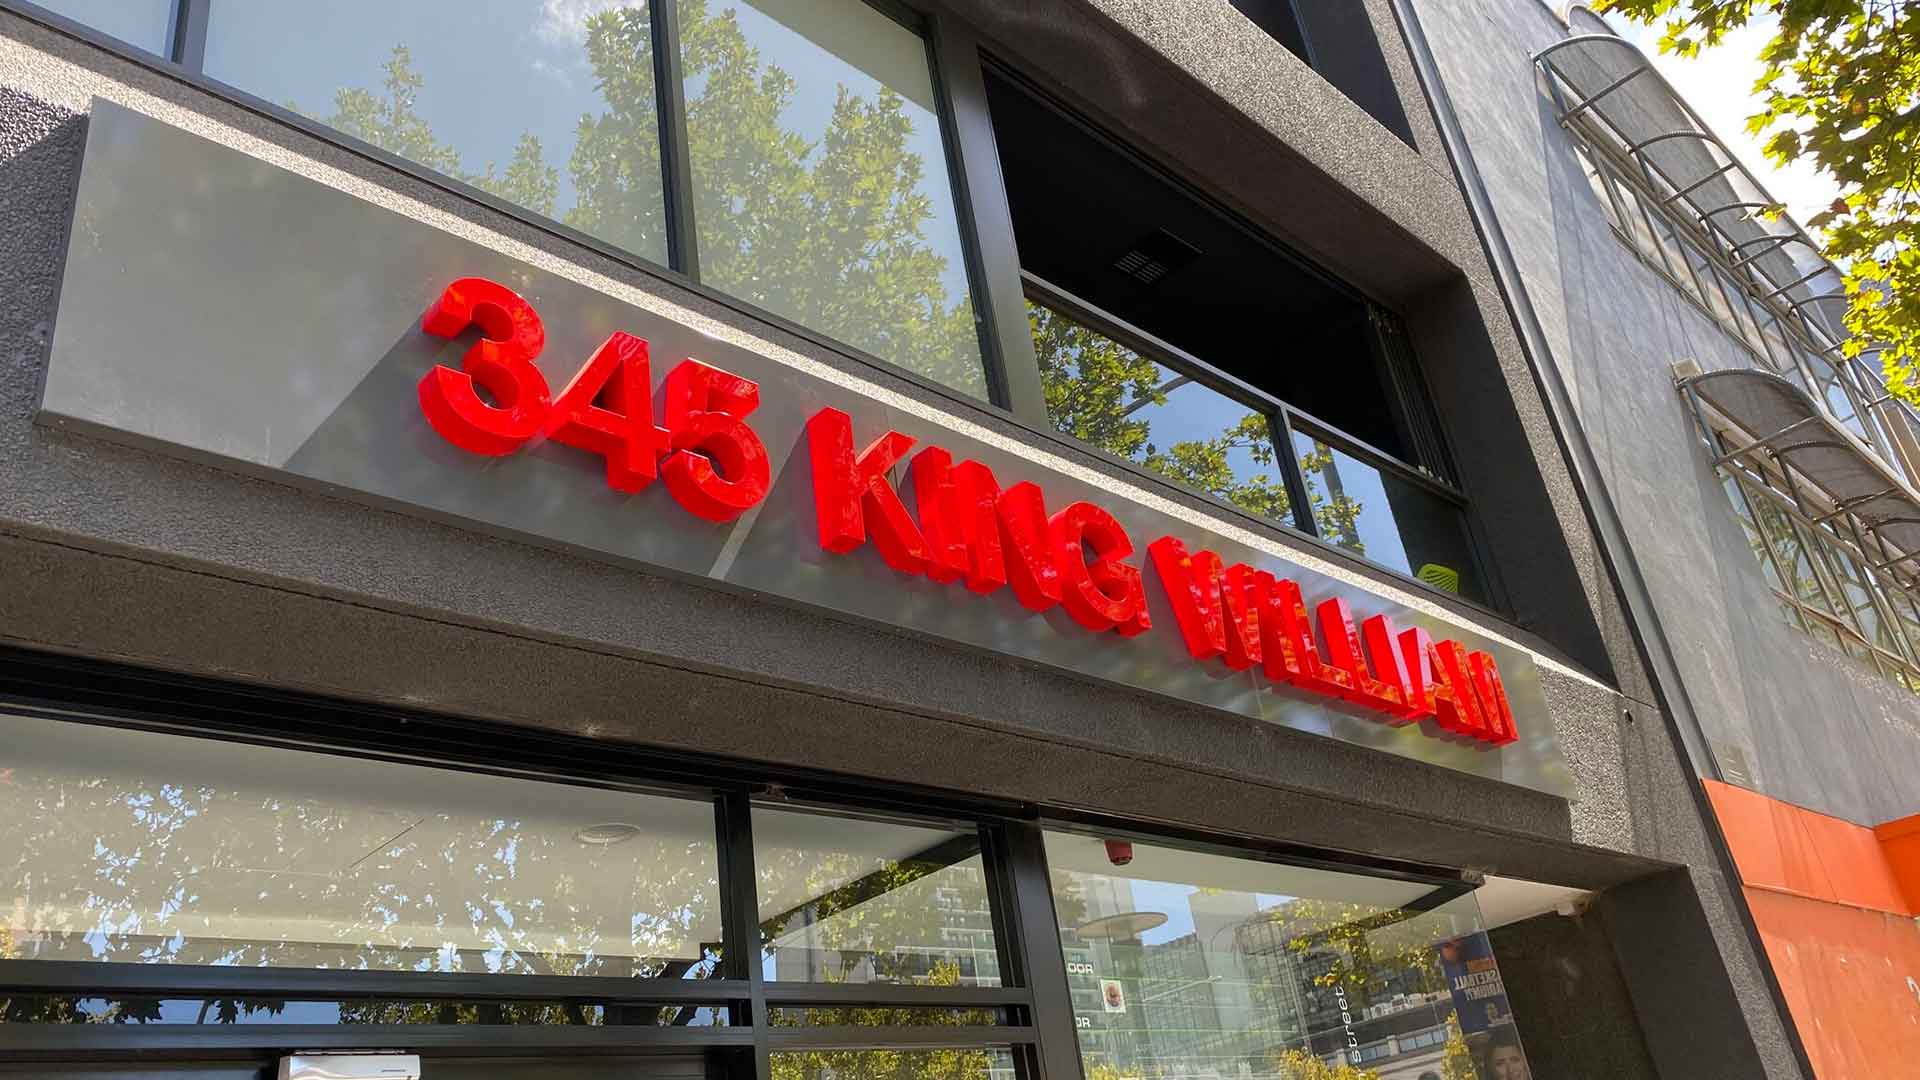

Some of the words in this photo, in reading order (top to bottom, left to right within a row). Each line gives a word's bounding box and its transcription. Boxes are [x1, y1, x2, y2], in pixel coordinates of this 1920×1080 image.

[417, 276, 771, 523] 345
[805, 406, 1153, 638] KING
[1147, 535, 1519, 746] WILLIAM
[1335, 985, 1362, 1063] street
